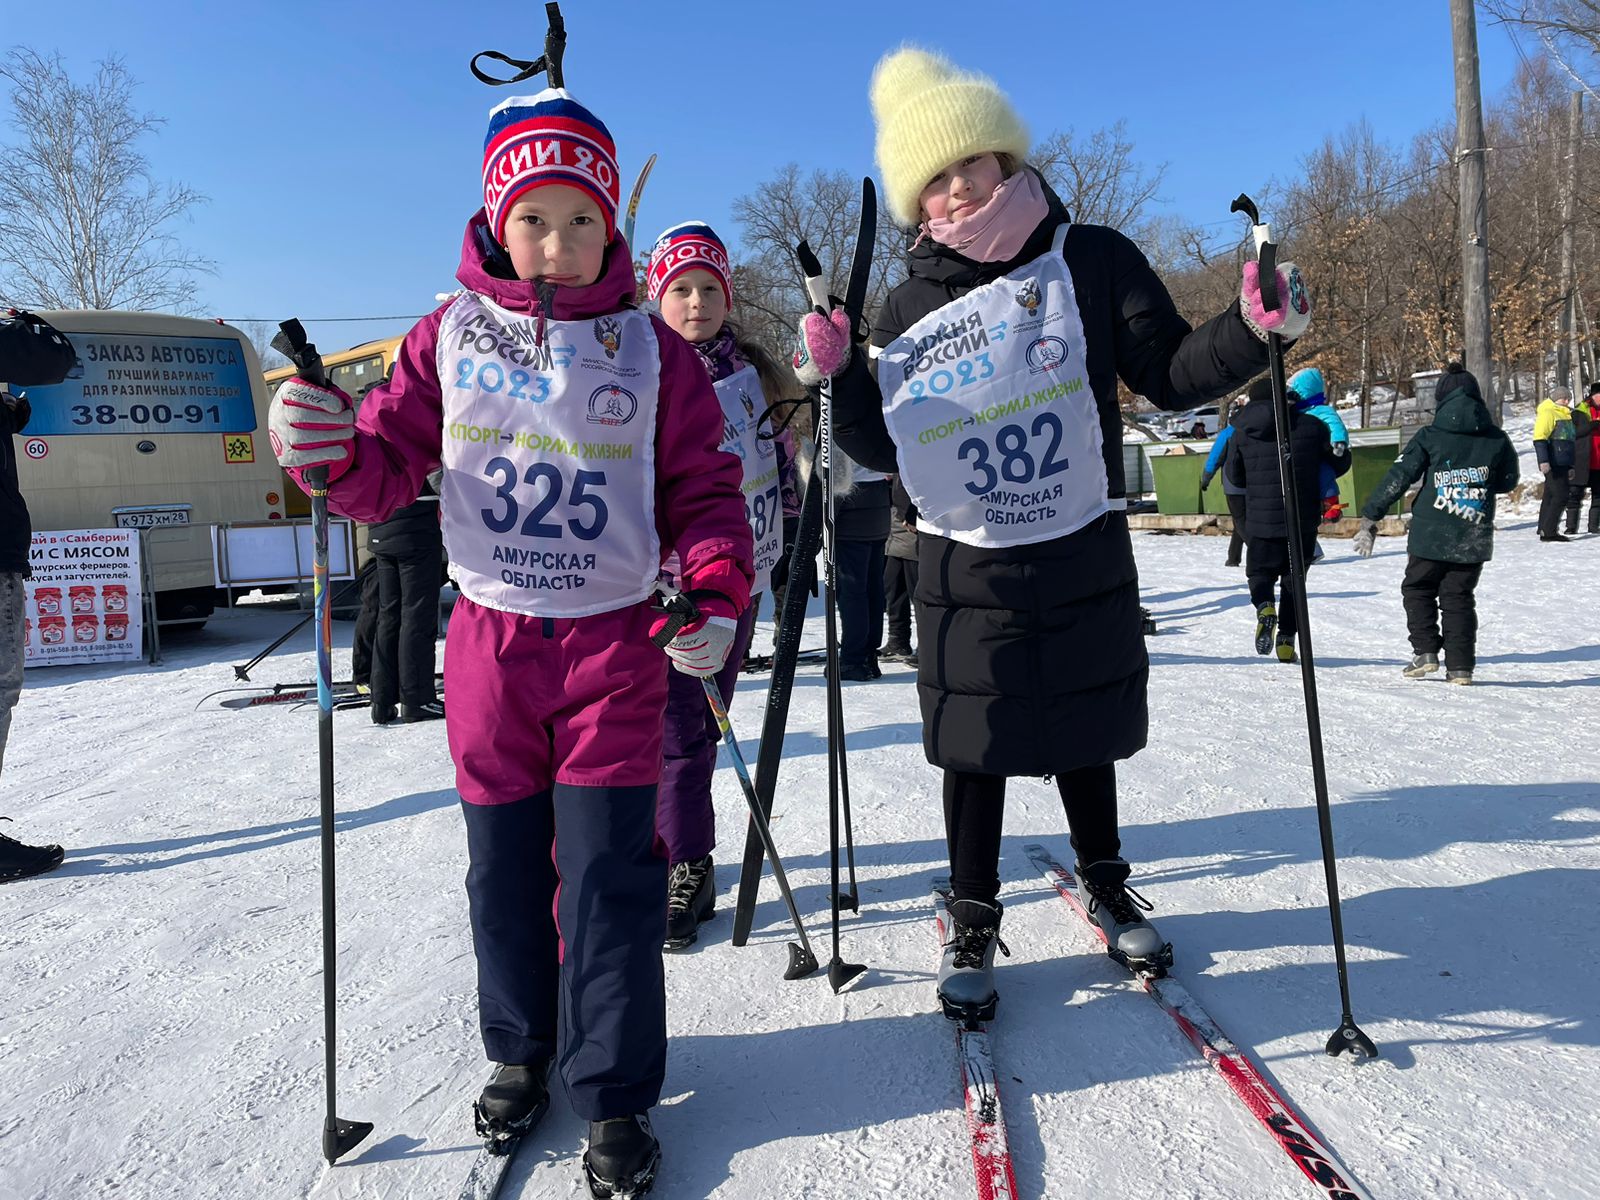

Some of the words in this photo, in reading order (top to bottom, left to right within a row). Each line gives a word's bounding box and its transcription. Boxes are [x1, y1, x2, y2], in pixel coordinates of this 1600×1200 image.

[87, 343, 145, 363] ЗАКАЗ
[151, 346, 238, 366] АВТОБУСА
[457, 329, 556, 372] РОССИИ
[903, 328, 990, 381] РОССИИ
[107, 368, 160, 381] ЛУЧШИЙ
[164, 371, 215, 383] ВАРИАНТ
[453, 357, 553, 404] 2023
[908, 351, 996, 405] 2023
[82, 386, 109, 398] ДЛЯ
[111, 384, 187, 396] РАЗЛИЧНЫХ
[189, 387, 240, 398] ПОЕЗДОК
[287, 387, 327, 404] ziener
[71, 403, 221, 426] 38-00-91
[917, 417, 964, 446] СПОРТ
[974, 398, 1032, 425] НОРМА
[1031, 376, 1084, 406] ЖИЗНИ
[450, 421, 501, 445] СПОРТ
[514, 431, 579, 460] НОРМА
[581, 442, 633, 460] ЖИЗНИ
[821, 399, 830, 464] NORDWAY
[28, 444, 45, 455] 60
[957, 412, 1069, 496] 382
[480, 456, 609, 541] 325
[979, 484, 1063, 507] АМУРСКАЯ
[745, 485, 778, 542] 87
[985, 506, 1057, 525] ОБЛАСТЬ
[1433, 495, 1486, 525] DWRT
[31, 535, 47, 545] ай
[50, 536, 57, 544] в
[60, 533, 130, 545] «Самбери»!
[48, 548, 59, 559] С
[64, 546, 129, 558] МЯСОМ
[492, 545, 596, 570] АМУРСКАЯ
[64, 572, 131, 581] загустителей.
[79, 562, 131, 571] фермеров.
[501, 569, 586, 591] ОБЛАСТЬ
[248, 691, 307, 706] NORDWAY
